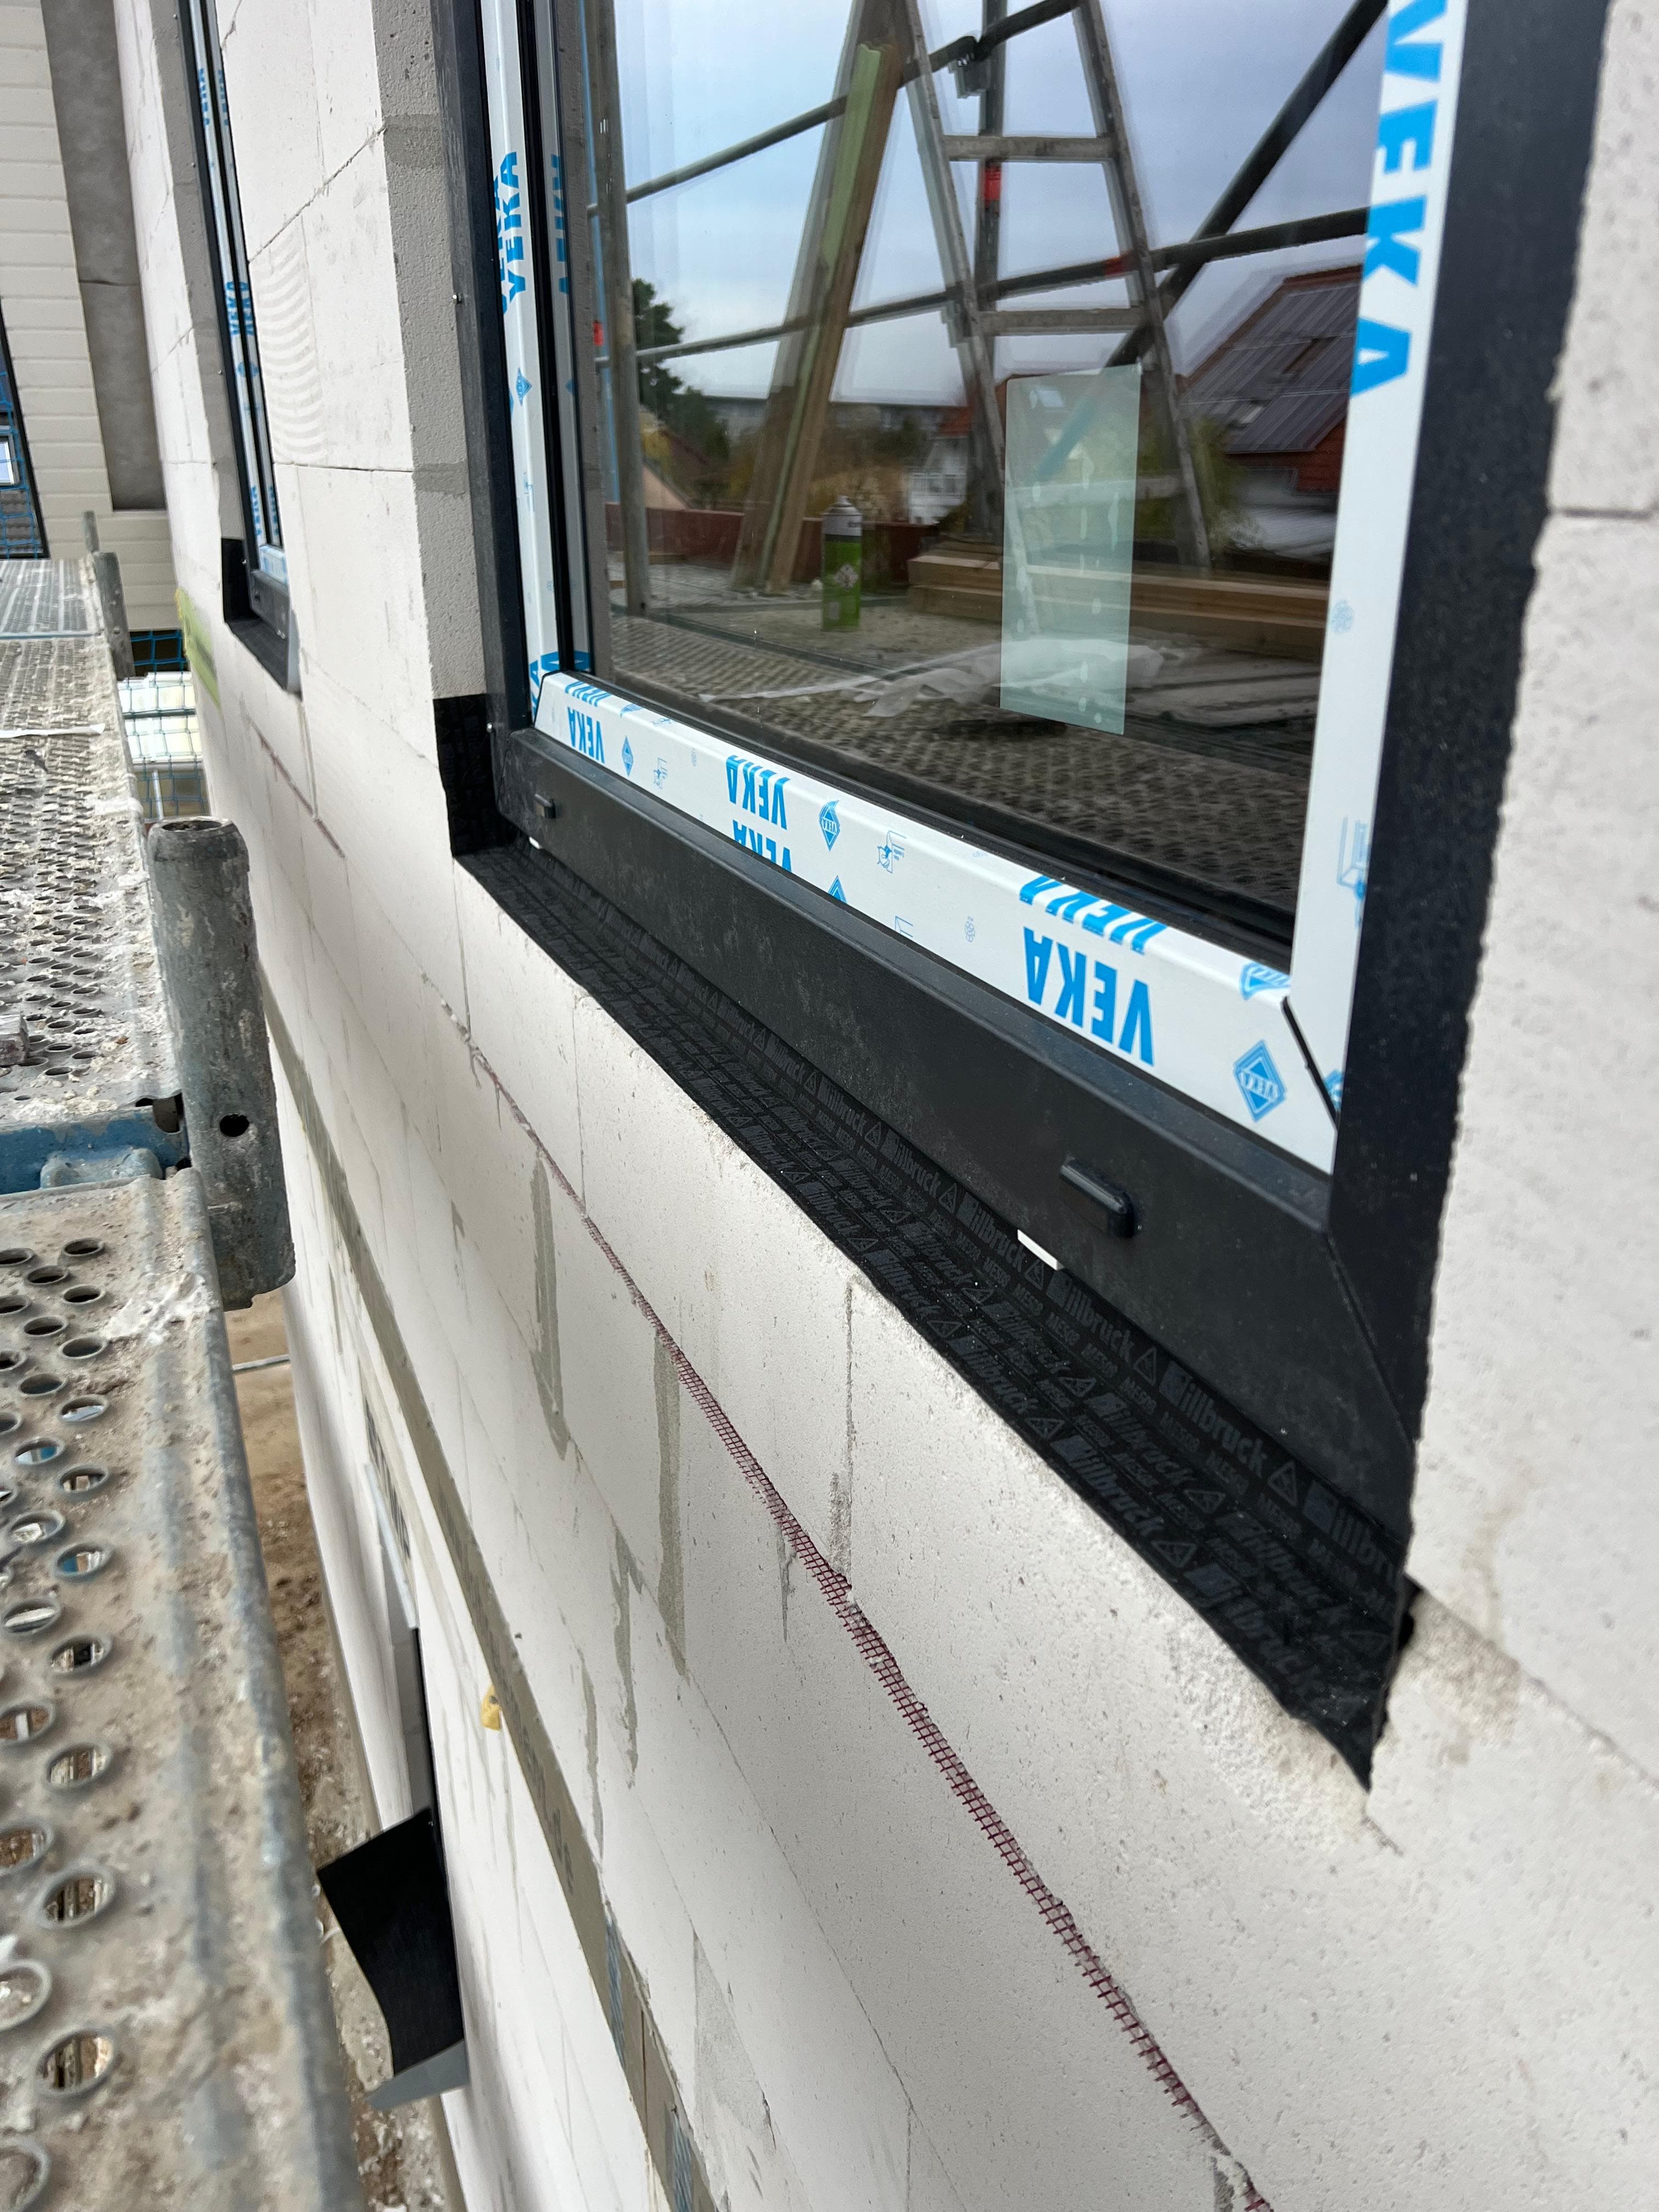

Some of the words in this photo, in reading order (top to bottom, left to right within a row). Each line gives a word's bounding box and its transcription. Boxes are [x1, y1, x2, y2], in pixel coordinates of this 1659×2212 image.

[500, 151, 526, 303] VEKA
[1350, 0, 1447, 398] VEKA
[567, 706, 605, 764] VEKA
[725, 754, 791, 830] VEKA
[1023, 927, 1154, 1066] VEKA
[827, 1084, 867, 1136] illbruck
[893, 1143, 941, 1199] illbruck
[970, 1205, 1026, 1273] illbruck
[1064, 1286, 1135, 1363] illbruck
[1180, 1382, 1267, 1479] illbruck
